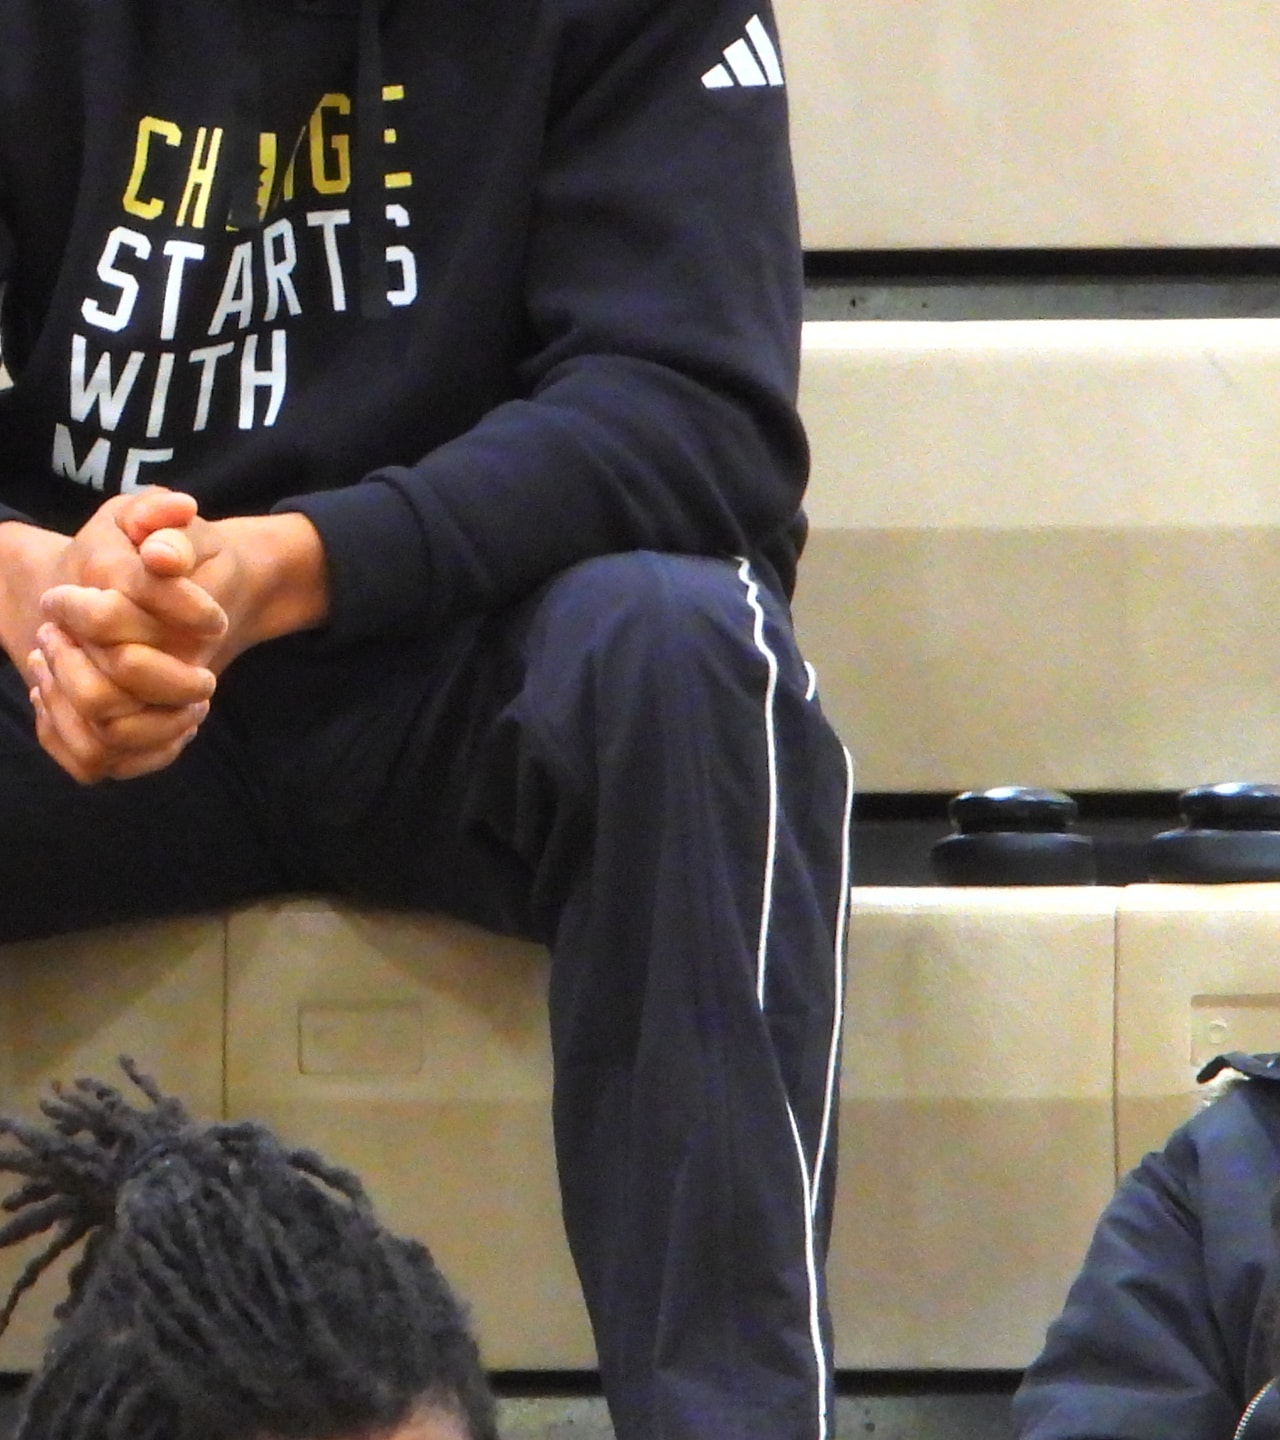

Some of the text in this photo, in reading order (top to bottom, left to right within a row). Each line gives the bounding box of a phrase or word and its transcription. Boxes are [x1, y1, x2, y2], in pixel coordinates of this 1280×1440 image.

[122, 85, 413, 232] CHGE
[80, 204, 418, 341] STARTS
[70, 329, 288, 437] WITH
